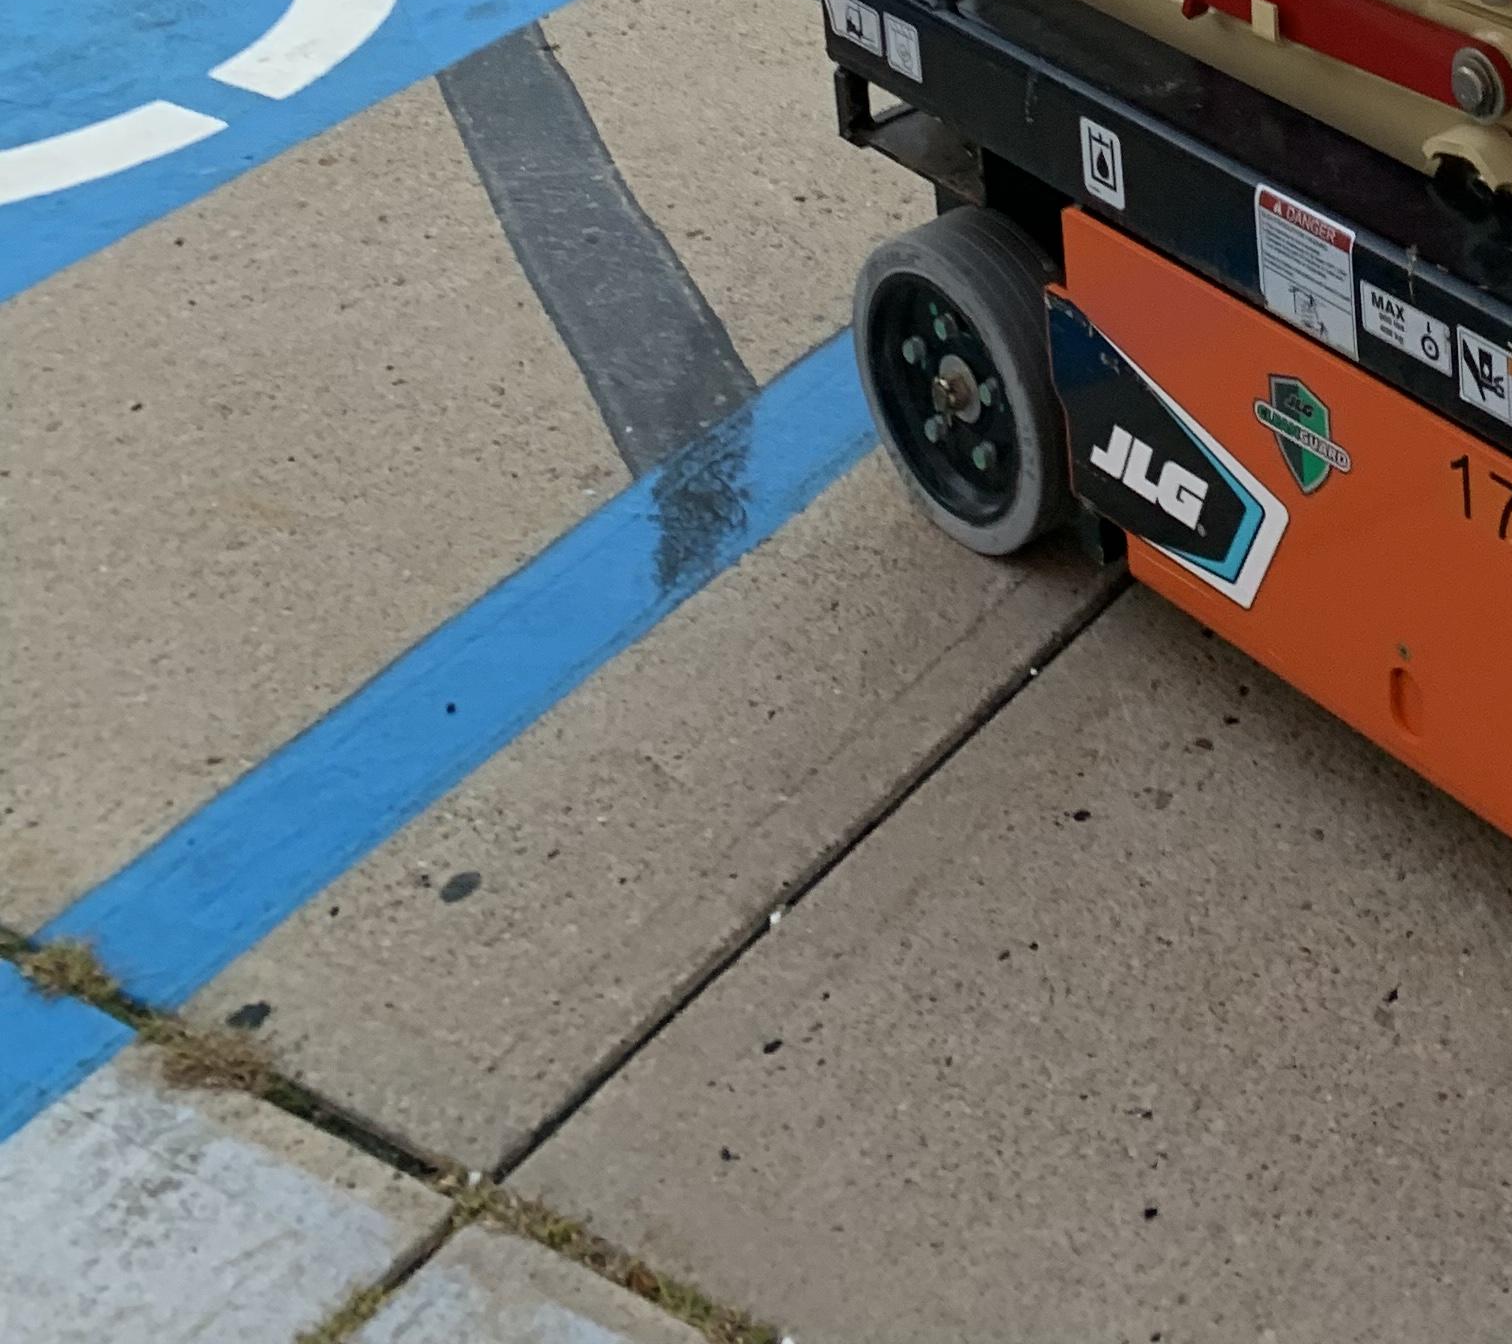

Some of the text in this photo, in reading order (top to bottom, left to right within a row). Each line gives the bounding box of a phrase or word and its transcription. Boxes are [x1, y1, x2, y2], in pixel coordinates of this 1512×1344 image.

[1285, 207, 1338, 244] DANGER
[1371, 291, 1406, 322] MAX
[1089, 424, 1209, 531] JLG
